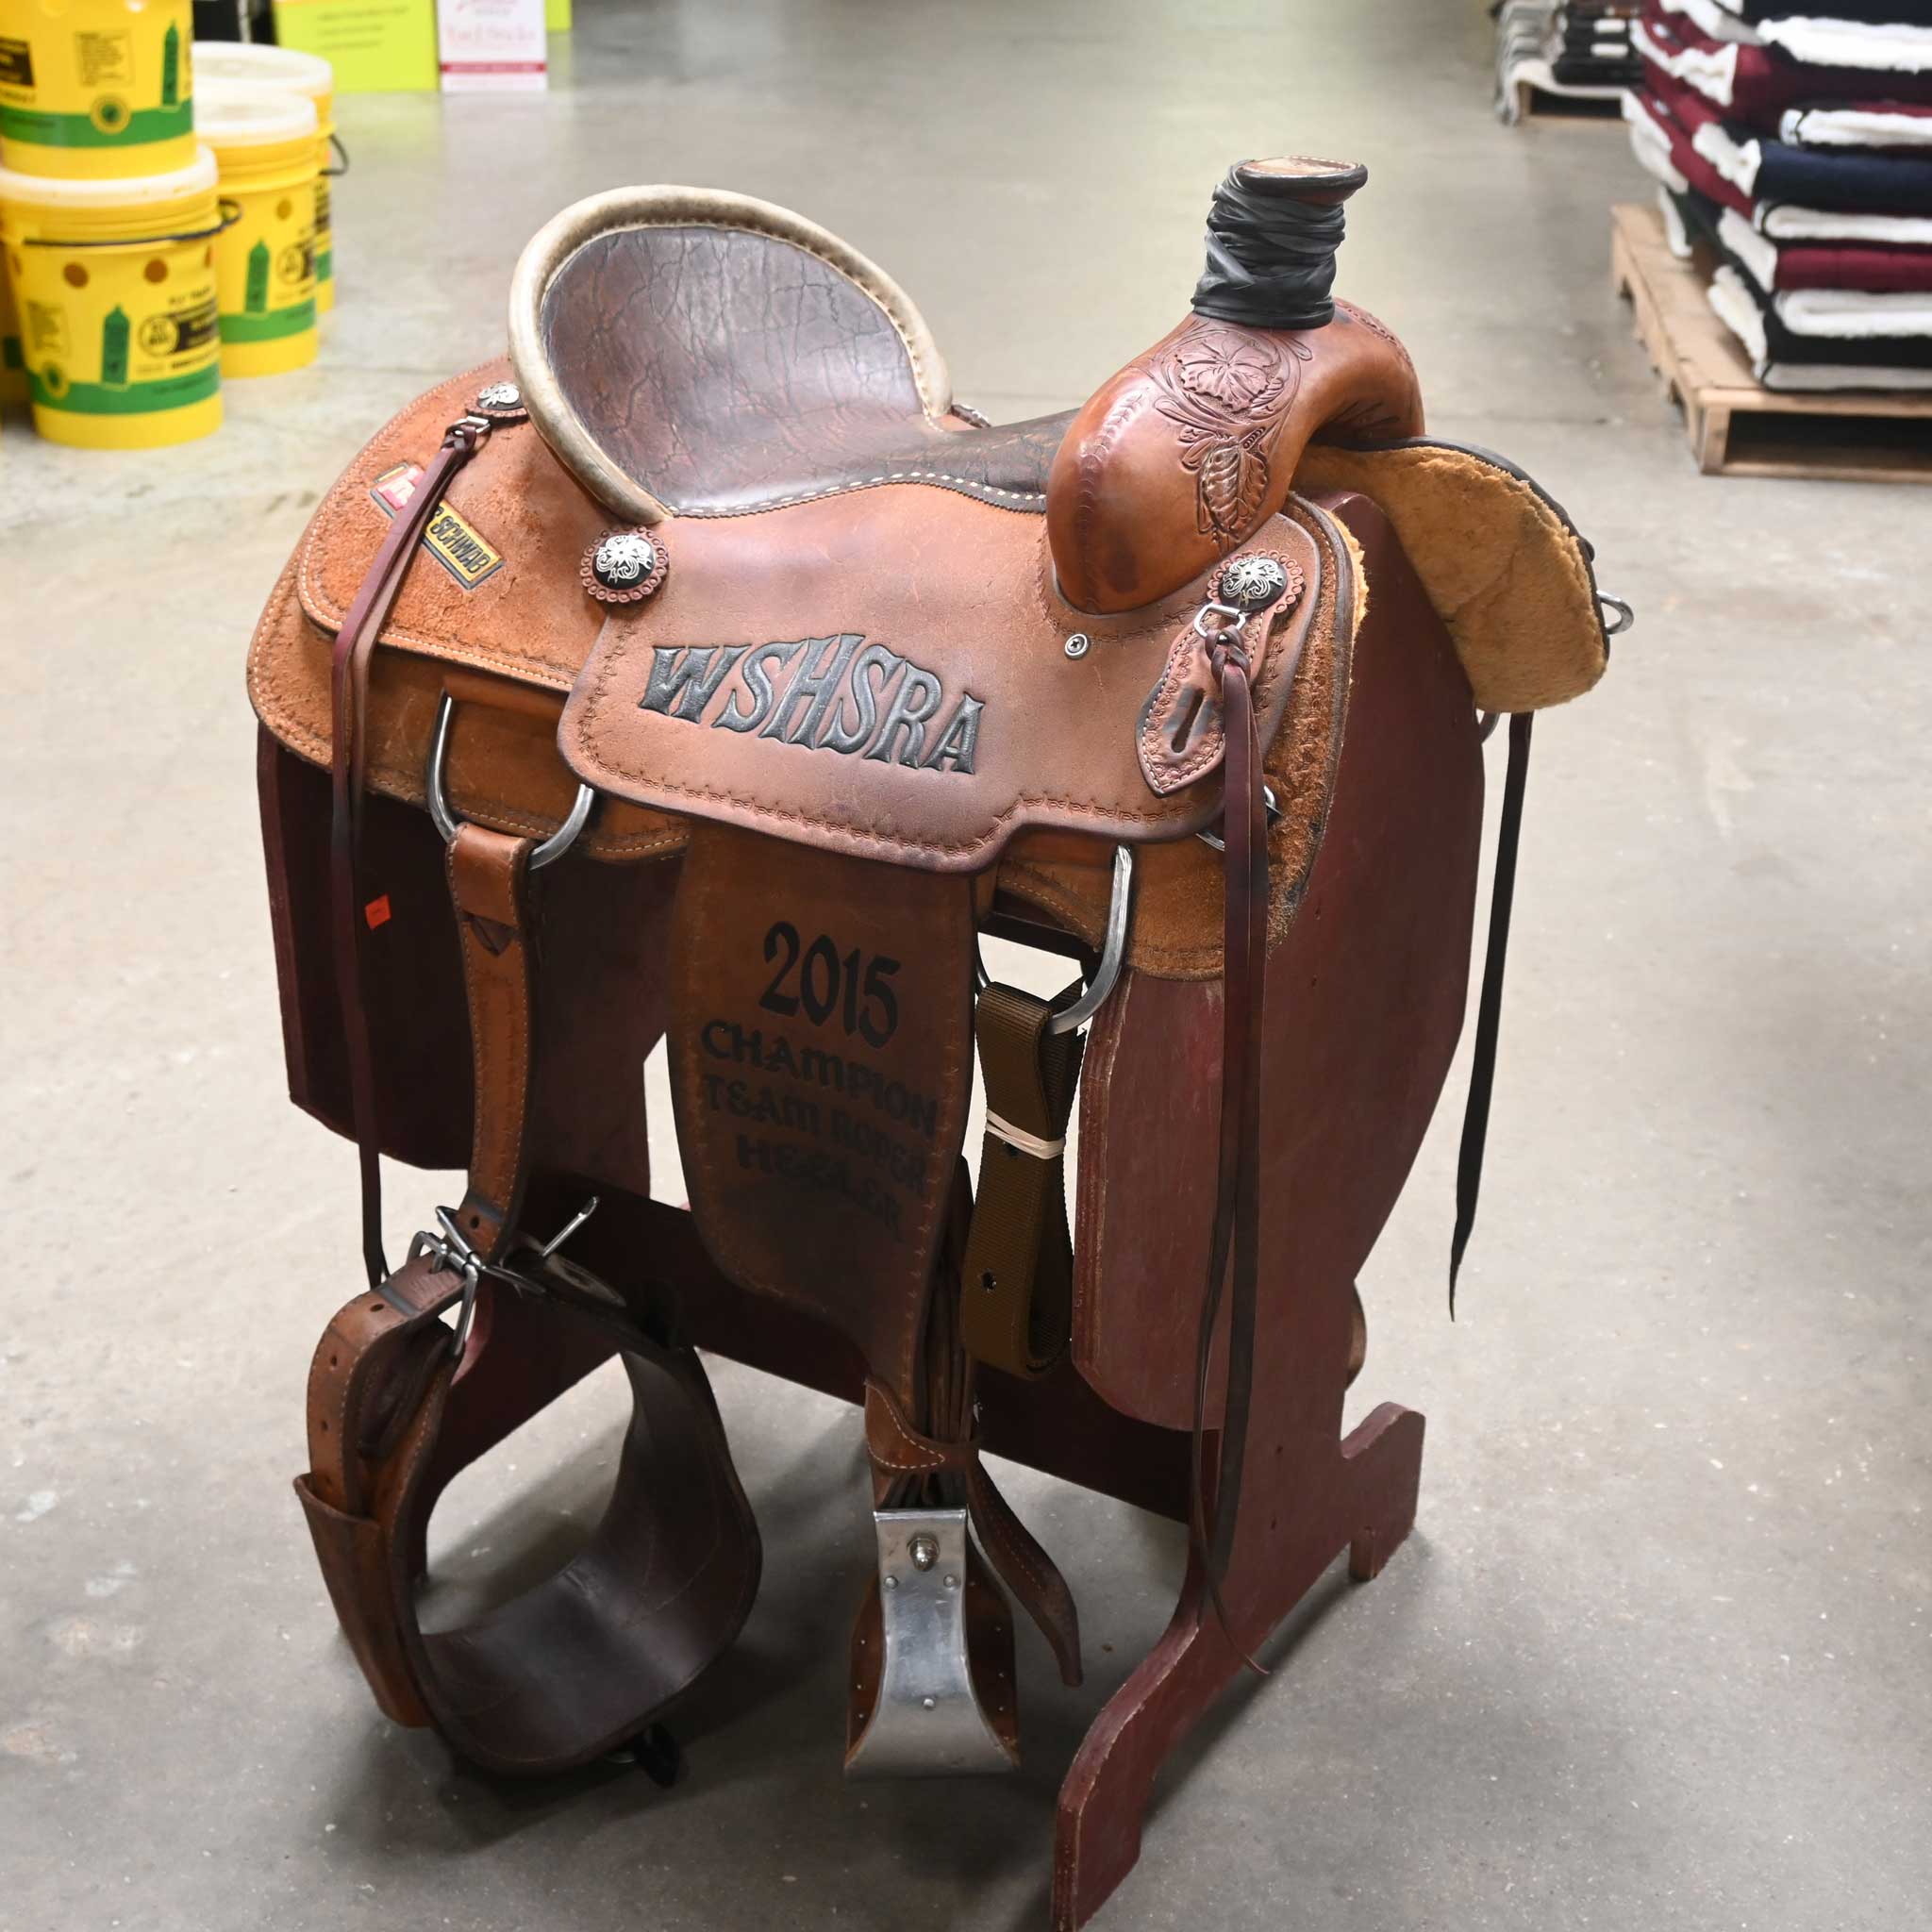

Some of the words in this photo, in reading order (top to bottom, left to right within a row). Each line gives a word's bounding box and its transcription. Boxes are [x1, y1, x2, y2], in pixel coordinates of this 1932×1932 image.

[429, 515, 491, 574] SCHWAB
[638, 633, 985, 774] WSHSRA
[758, 920, 901, 1049] 2015
